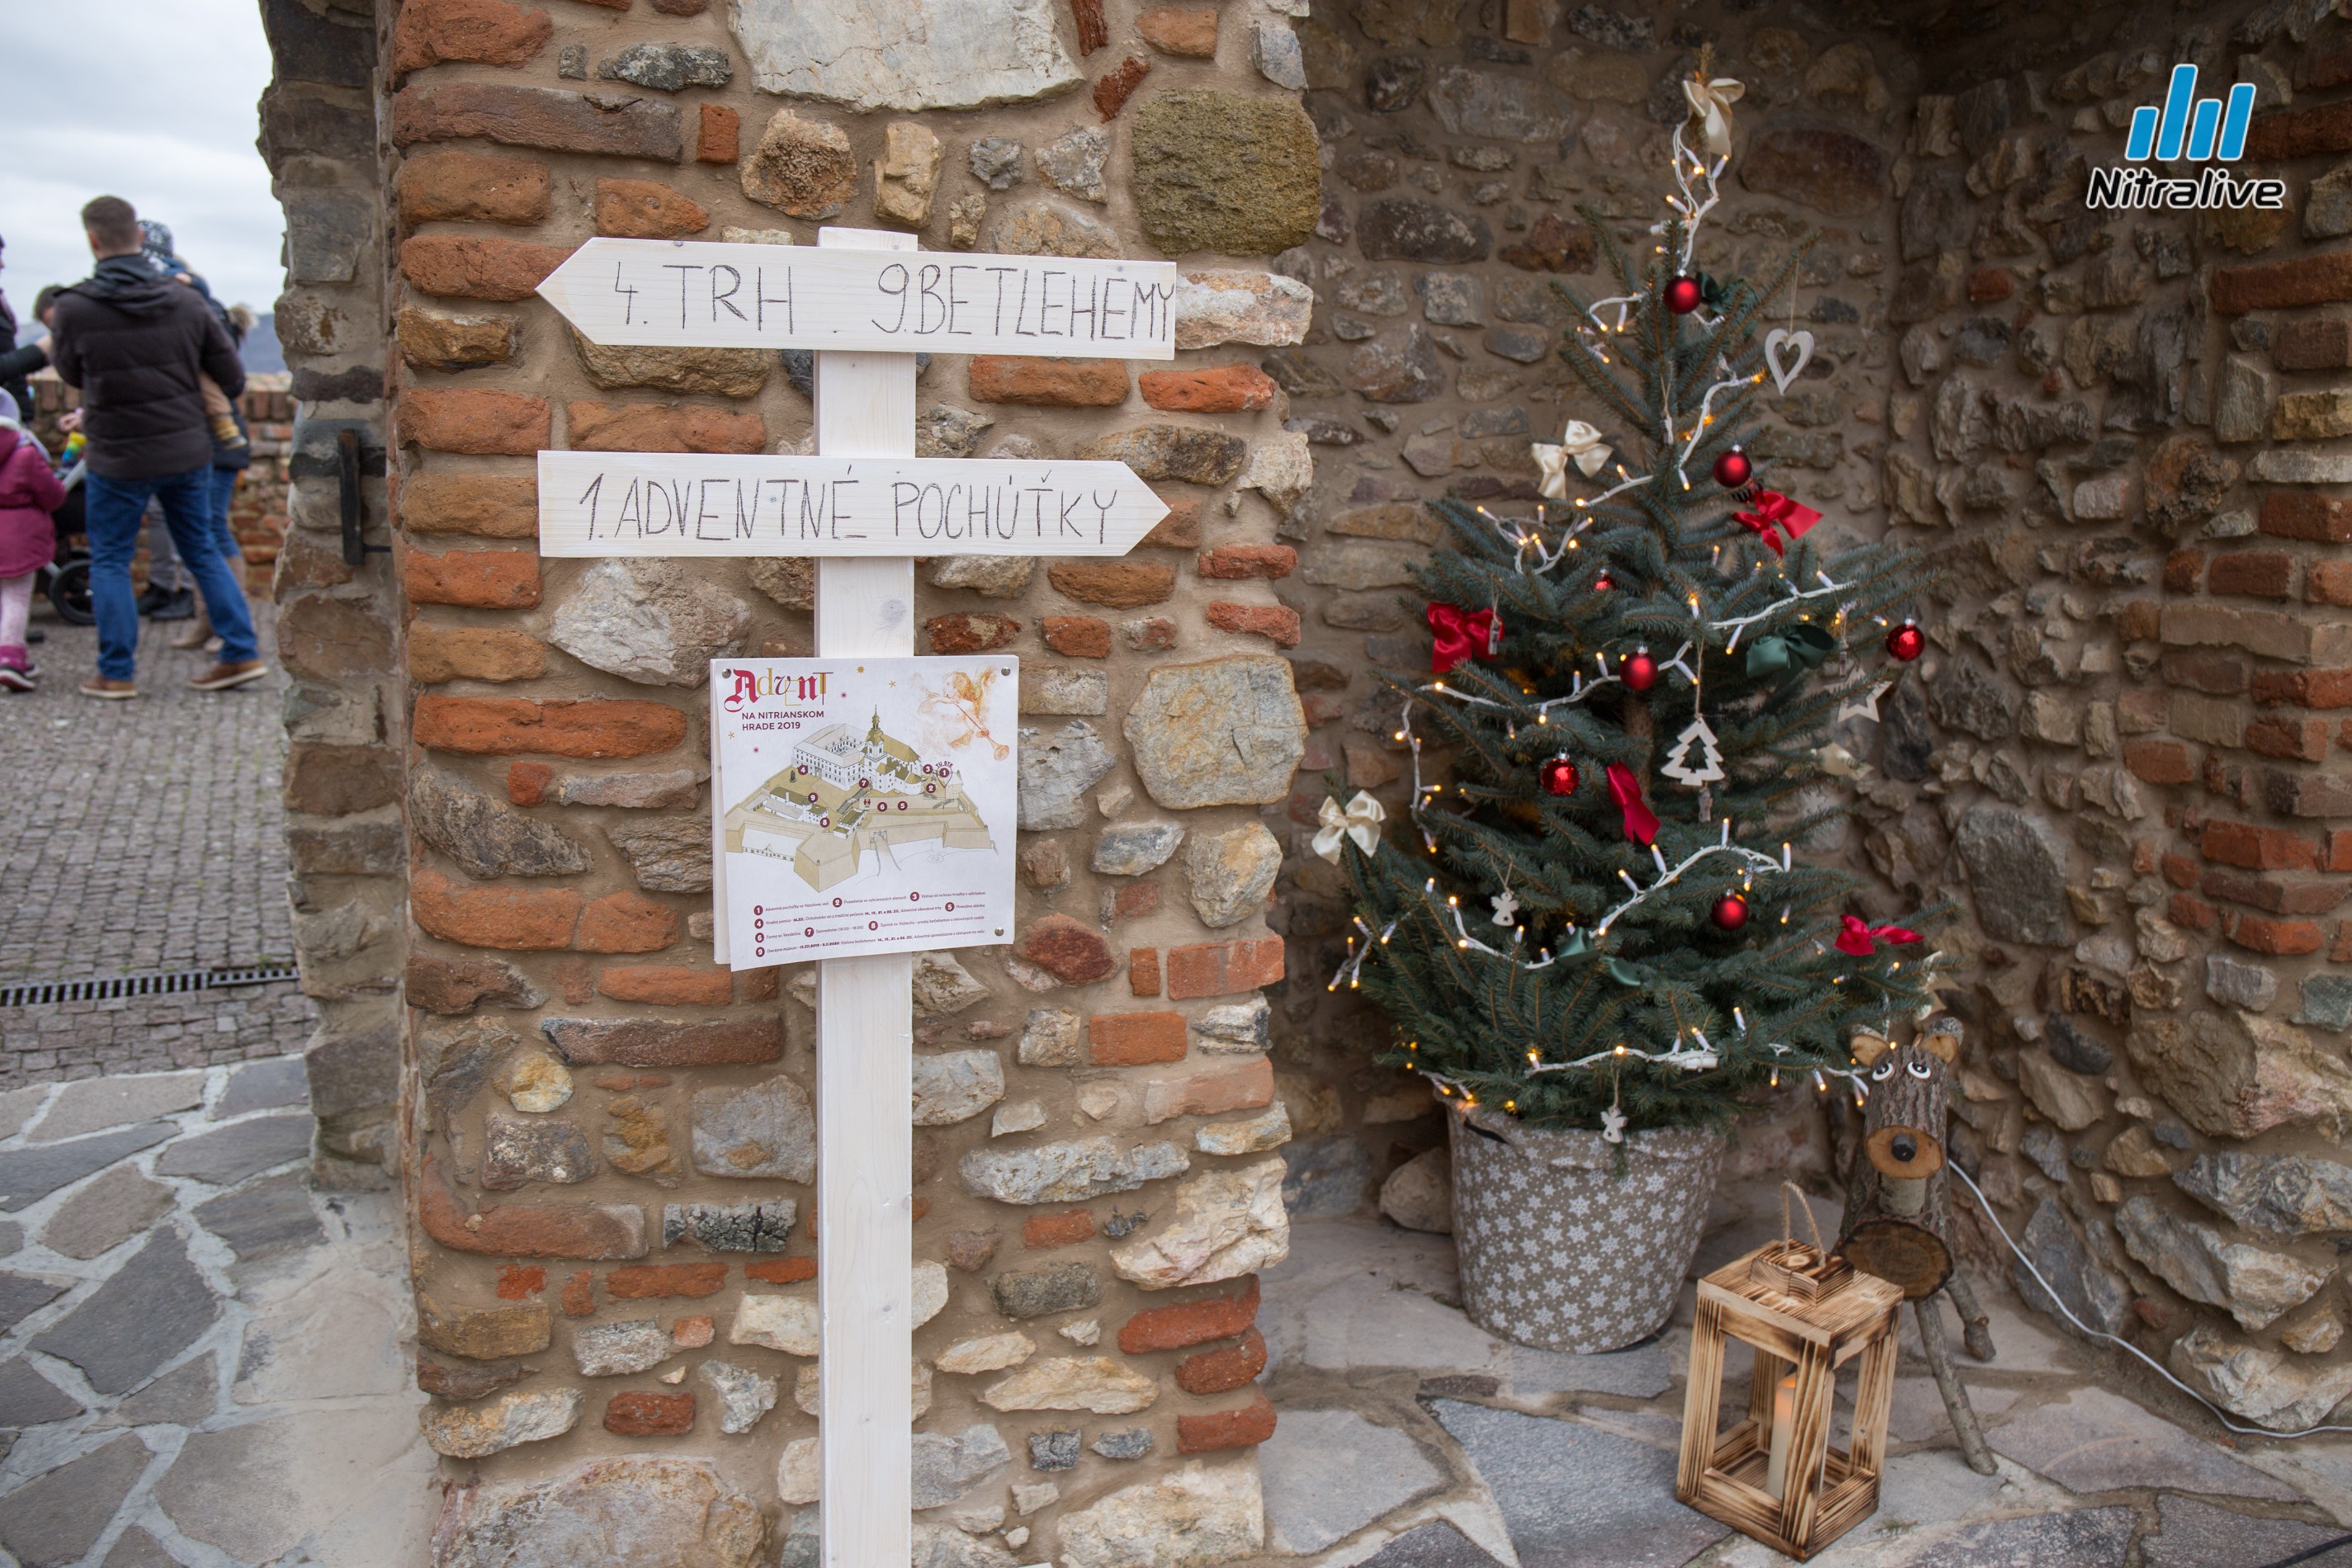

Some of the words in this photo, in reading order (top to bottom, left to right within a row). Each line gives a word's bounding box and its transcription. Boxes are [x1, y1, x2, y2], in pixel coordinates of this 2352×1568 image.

[662, 263, 795, 335] TRH
[758, 711, 824, 719] NITRIANSKOM
[742, 723, 775, 731] HRADE
[777, 721, 801, 730] 2019
